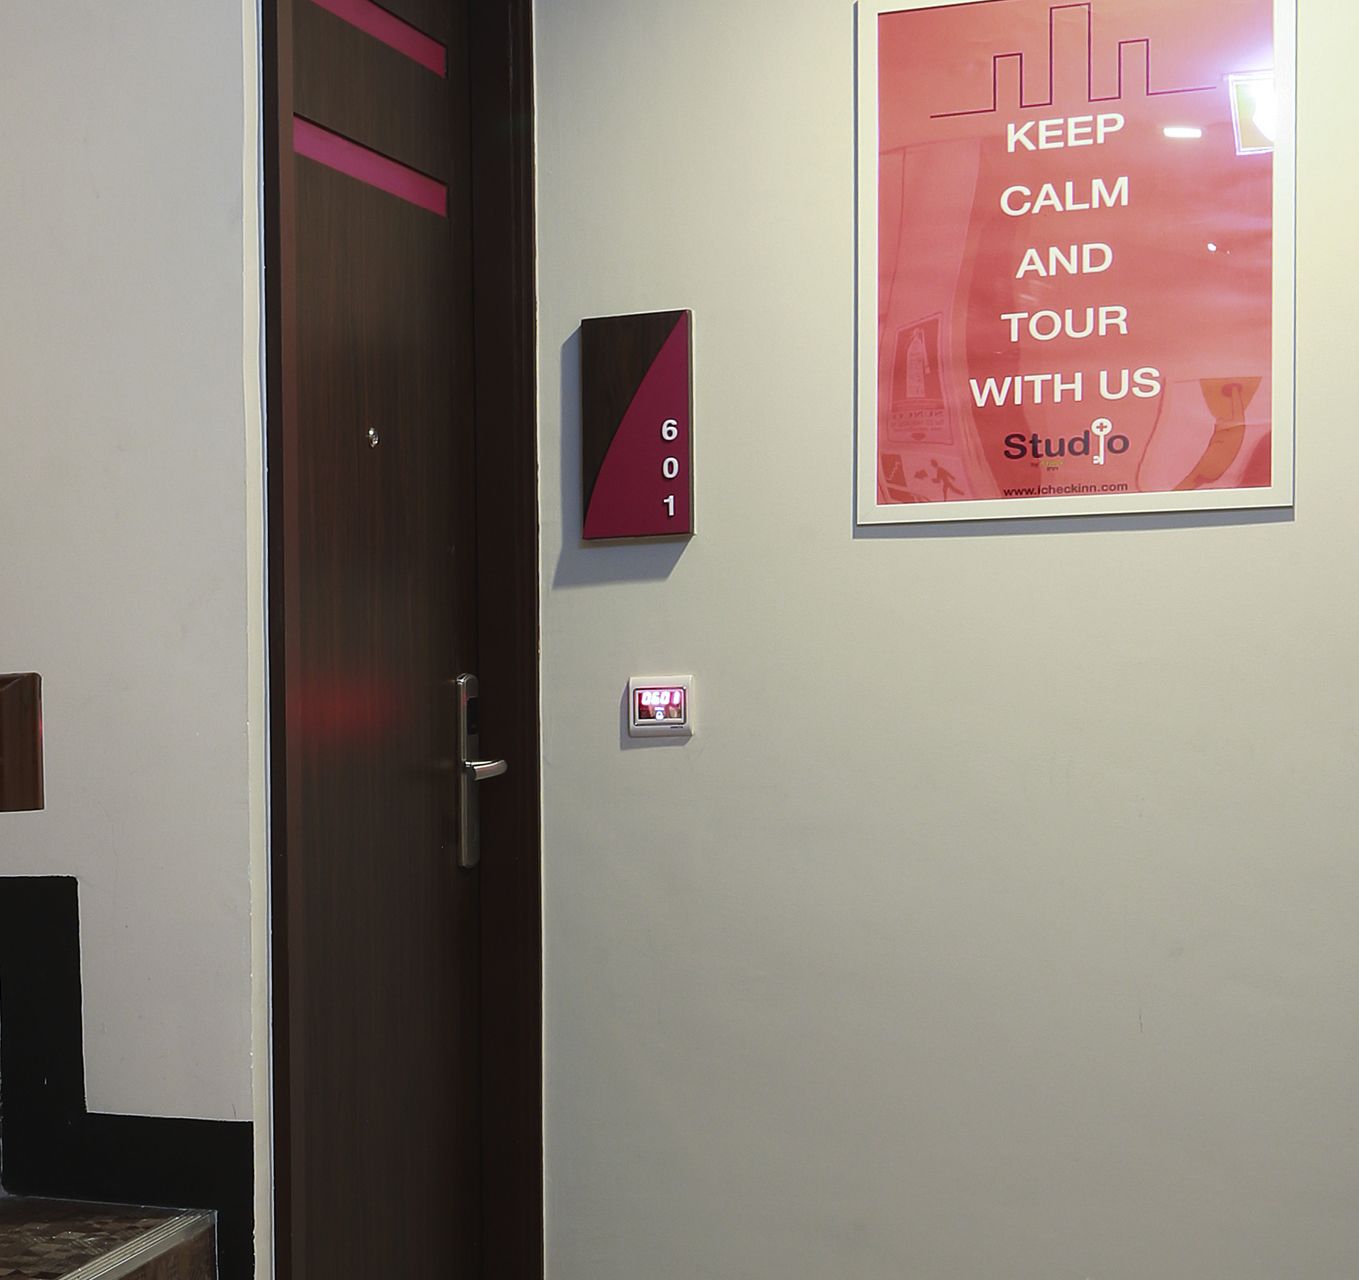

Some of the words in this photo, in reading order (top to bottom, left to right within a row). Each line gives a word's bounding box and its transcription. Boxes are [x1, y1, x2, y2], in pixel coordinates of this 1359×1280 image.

[1006, 112, 1125, 152] KEEP
[1000, 176, 1129, 216] CALM
[1015, 243, 1113, 279] AND
[1001, 305, 1128, 342] TOUR
[969, 372, 1082, 407] WITH
[1099, 367, 1161, 400] US
[1003, 483, 1129, 497] www.icheckinn.com
